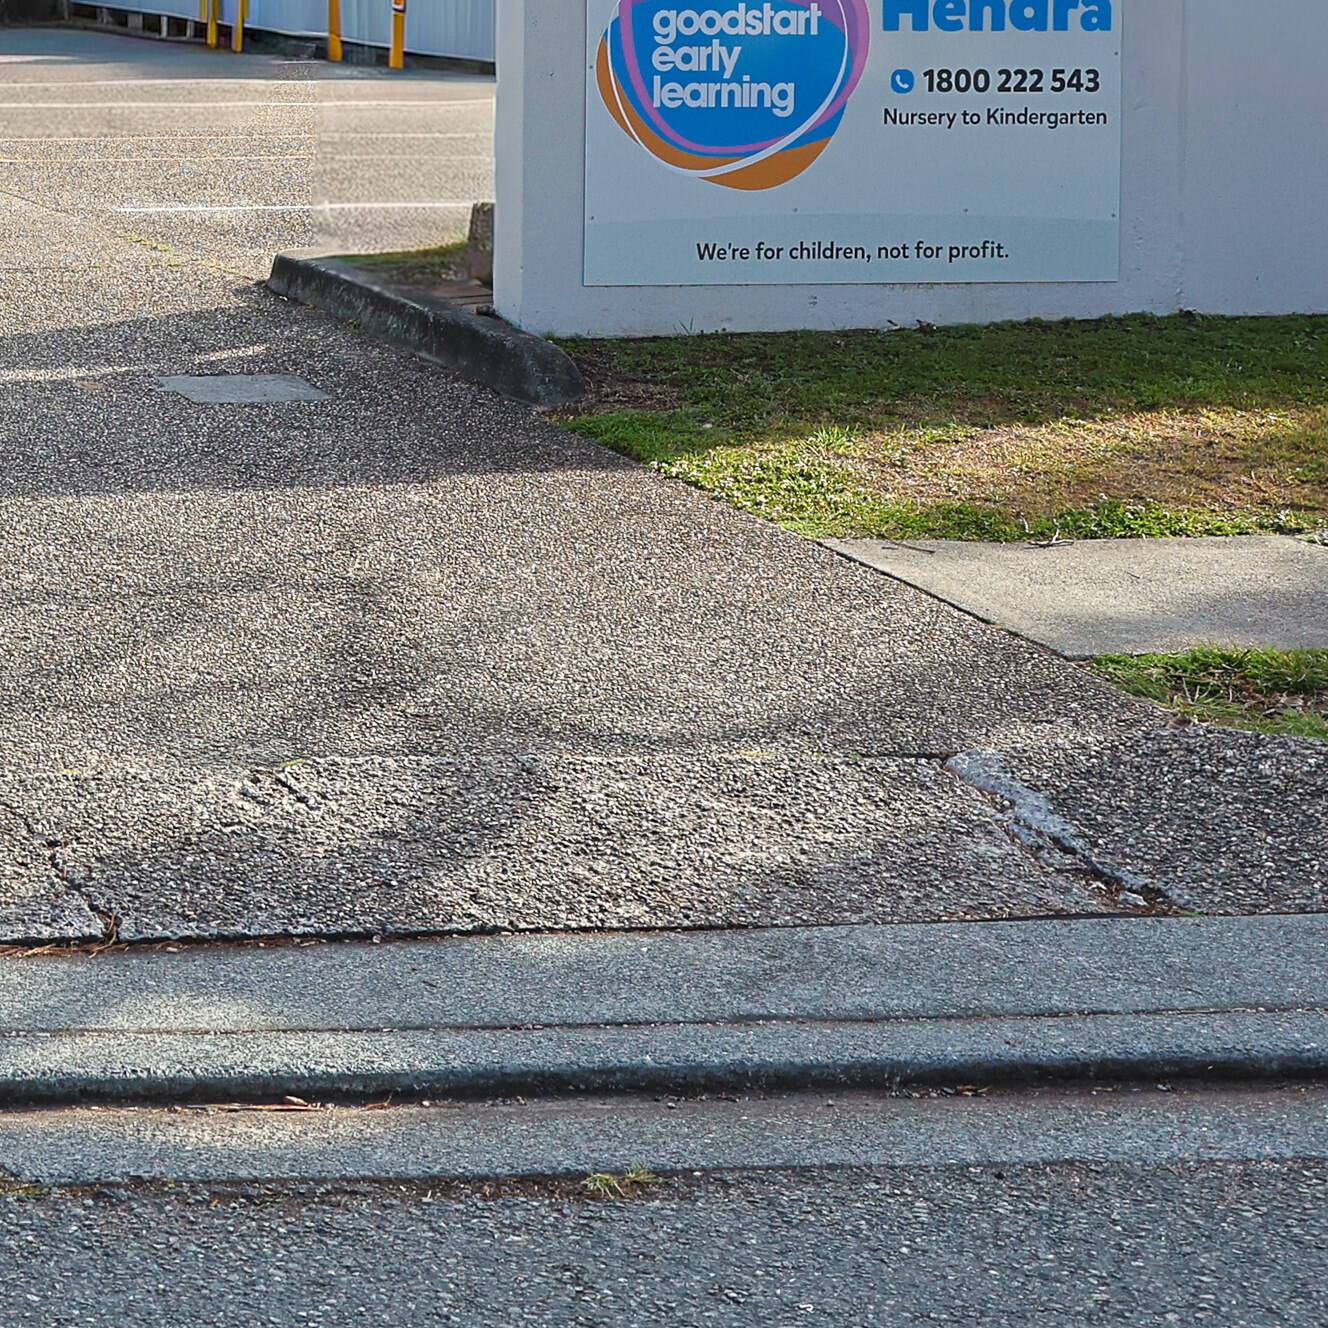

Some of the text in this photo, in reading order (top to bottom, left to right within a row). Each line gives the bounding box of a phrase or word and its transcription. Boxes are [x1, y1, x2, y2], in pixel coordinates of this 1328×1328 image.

[652, 2, 822, 45] goodstart
[652, 39, 742, 79] early
[653, 75, 795, 118] learning
[923, 69, 1100, 93] 1800 222 543
[883, 107, 1107, 129] Nursery to Kindergarten
[696, 240, 1009, 263] We're for children, not for profit.
